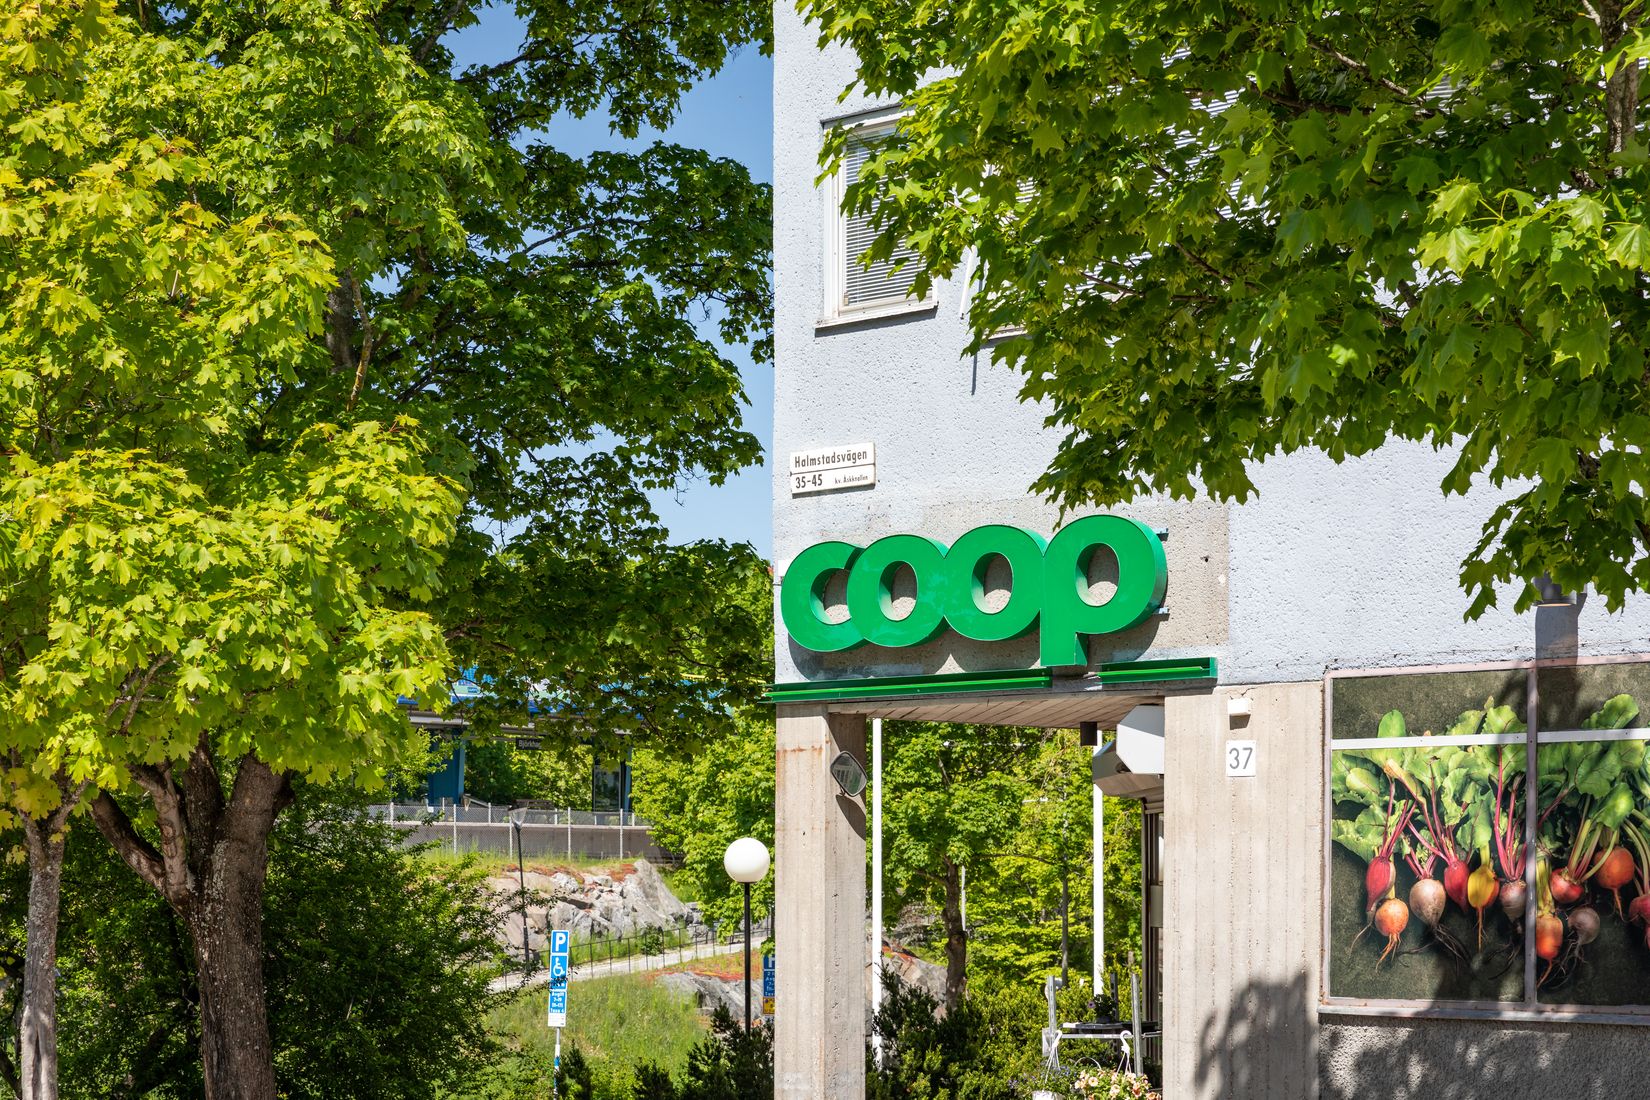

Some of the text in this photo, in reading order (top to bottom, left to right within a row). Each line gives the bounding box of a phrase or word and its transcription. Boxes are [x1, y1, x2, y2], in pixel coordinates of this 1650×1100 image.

[794, 449, 868, 468] Halmstadsvägen
[795, 473, 823, 489] 35-45
[780, 514, 1168, 667] coop
[1229, 747, 1253, 770] 37
[555, 932, 566, 952] P
